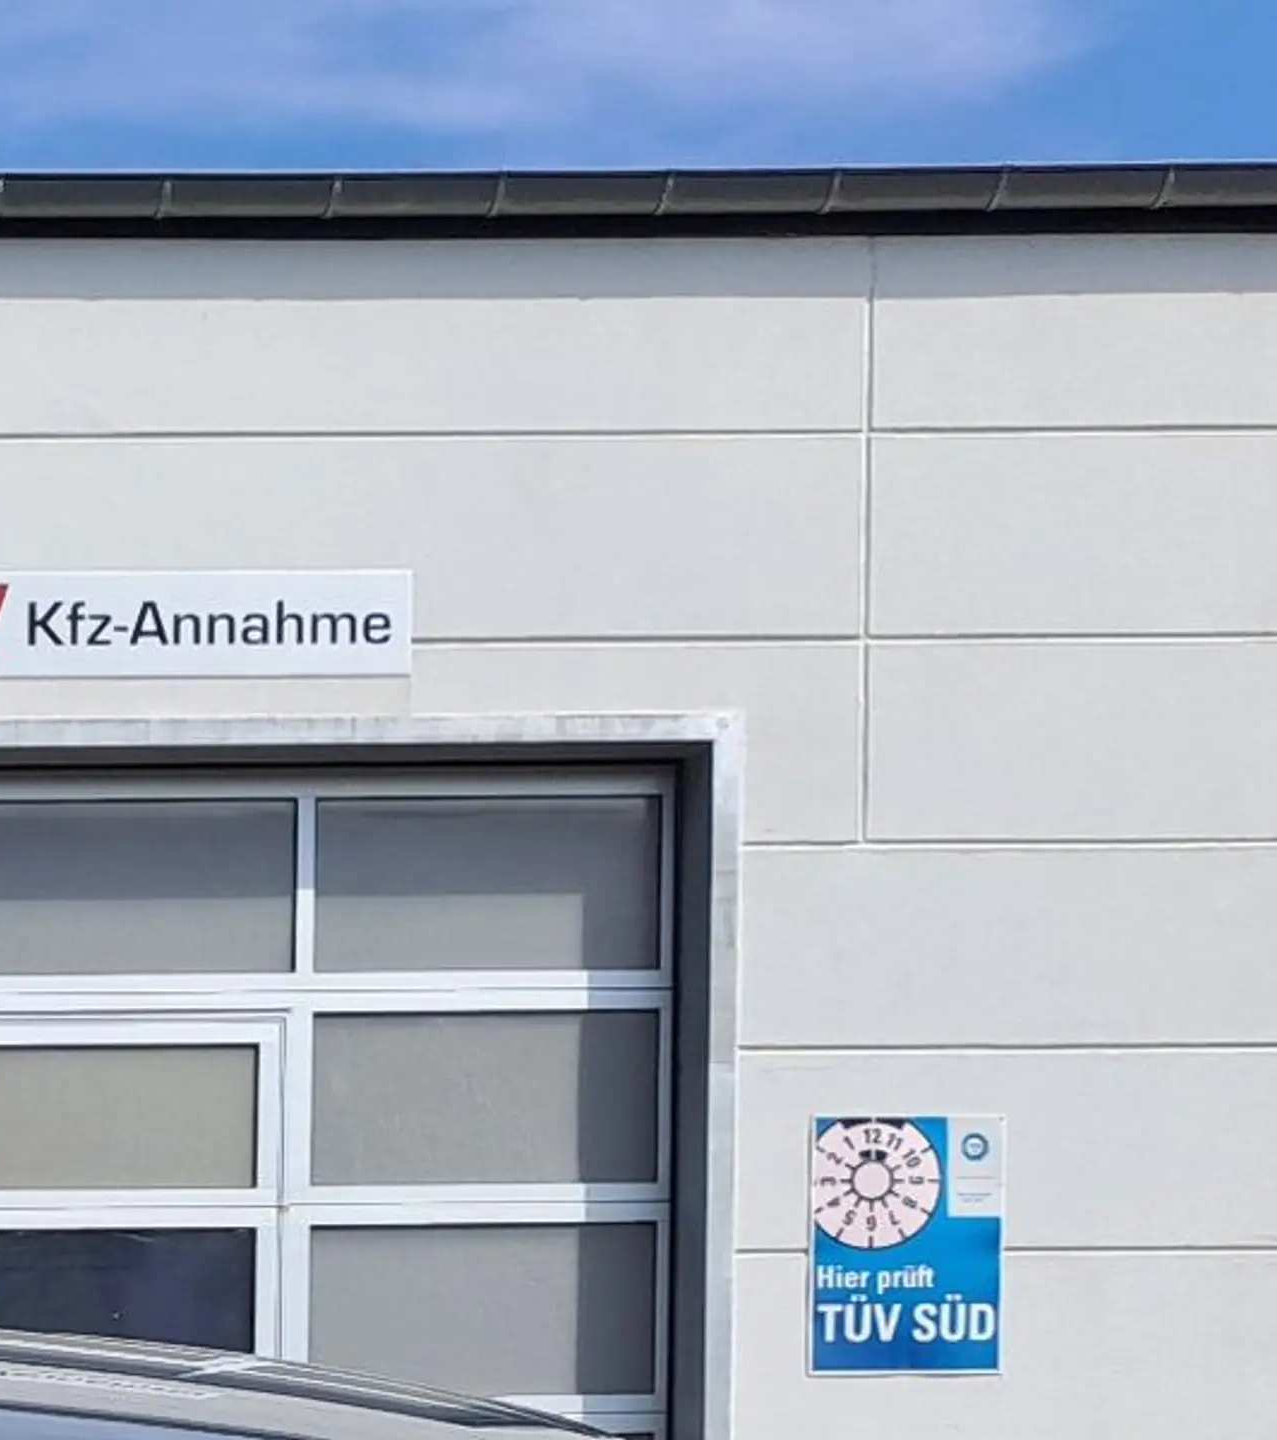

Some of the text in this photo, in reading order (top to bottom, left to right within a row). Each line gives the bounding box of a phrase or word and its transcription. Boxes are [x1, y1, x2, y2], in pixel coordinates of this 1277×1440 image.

[26, 599, 392, 647] Kfz-Annahme
[843, 1135, 855, 1150] 1
[863, 1127, 883, 1144] 12
[886, 1132, 903, 1151] 11
[826, 1151, 843, 1165] 2
[902, 1147, 922, 1168] 10
[820, 1176, 837, 1187] 3
[843, 1209, 857, 1226] 5
[866, 1214, 877, 1232] 6
[816, 1264, 936, 1295] Hier prüft
[816, 1293, 996, 1343] TÜV SÜD
